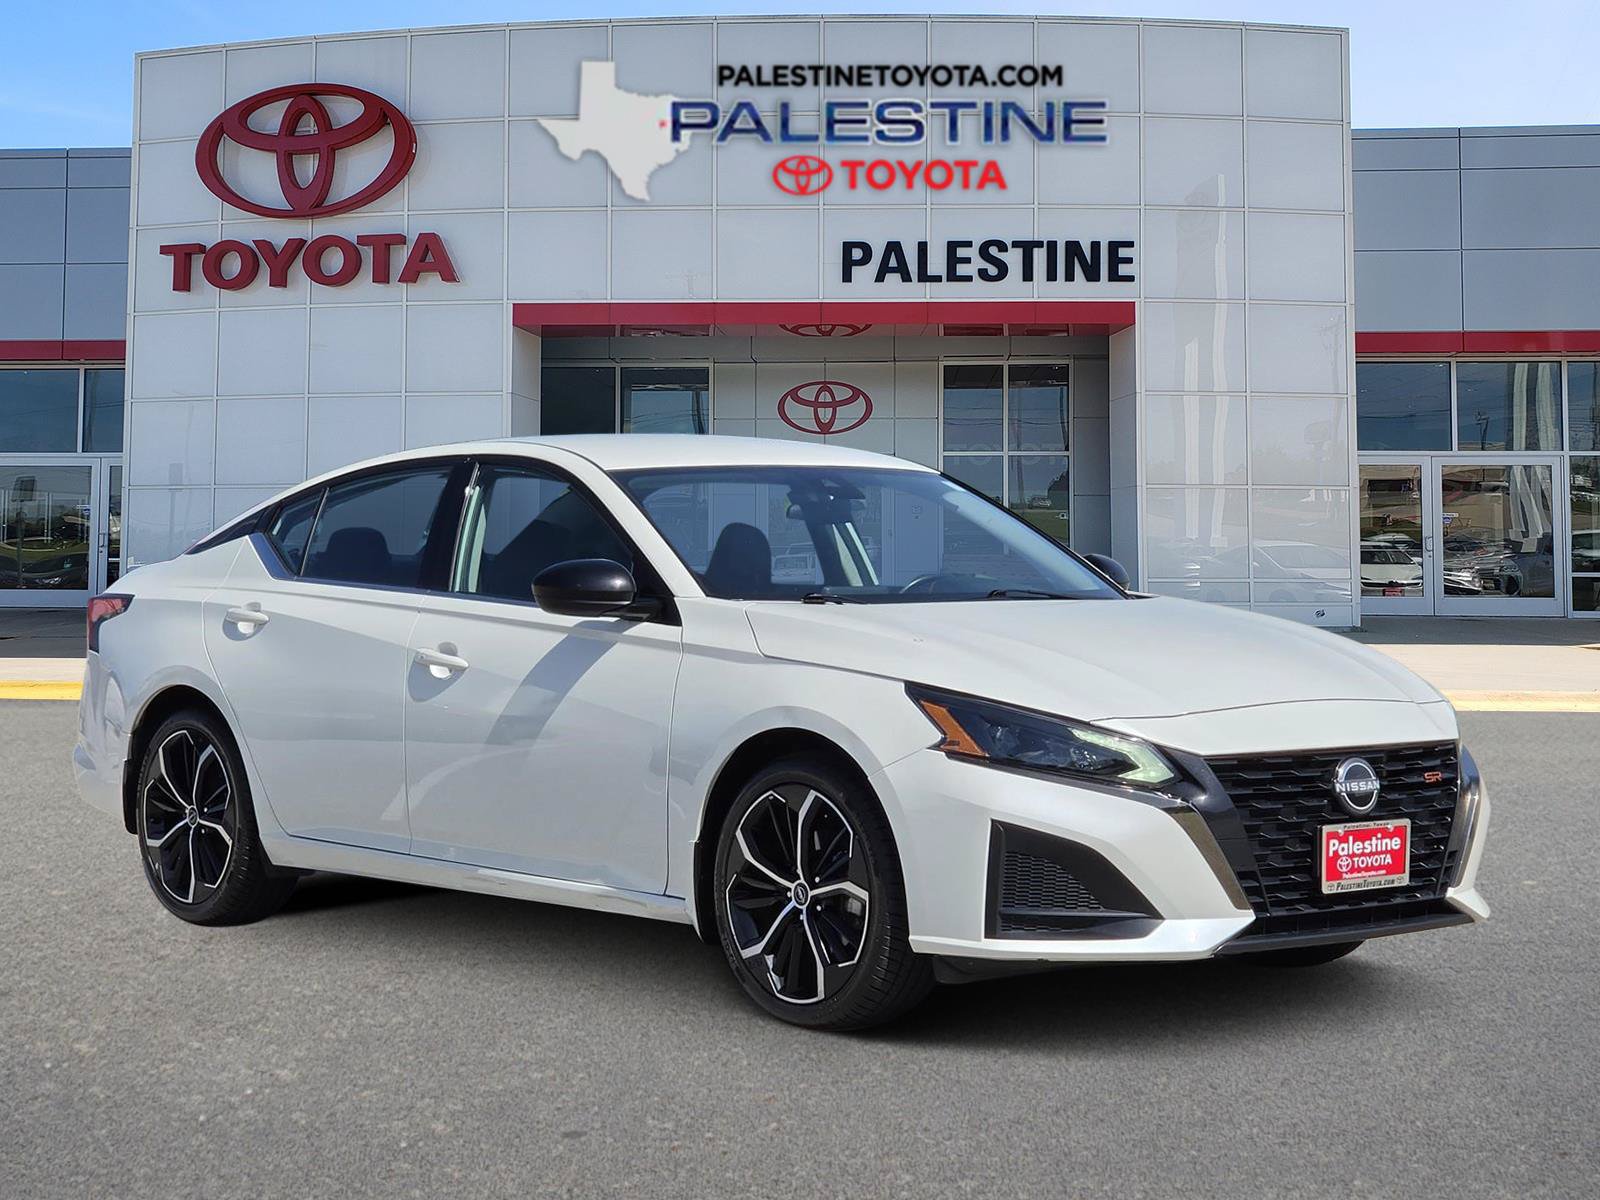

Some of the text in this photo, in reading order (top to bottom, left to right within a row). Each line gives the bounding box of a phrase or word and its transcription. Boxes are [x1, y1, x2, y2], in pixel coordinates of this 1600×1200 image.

[160, 233, 460, 291] TOYOTA
[841, 240, 1135, 283] PALESTINE
[1335, 780, 1380, 792] NISSAN
[1424, 771, 1442, 783] SR
[1328, 833, 1401, 857] Palestine
[1353, 854, 1392, 868] TOYOTA
